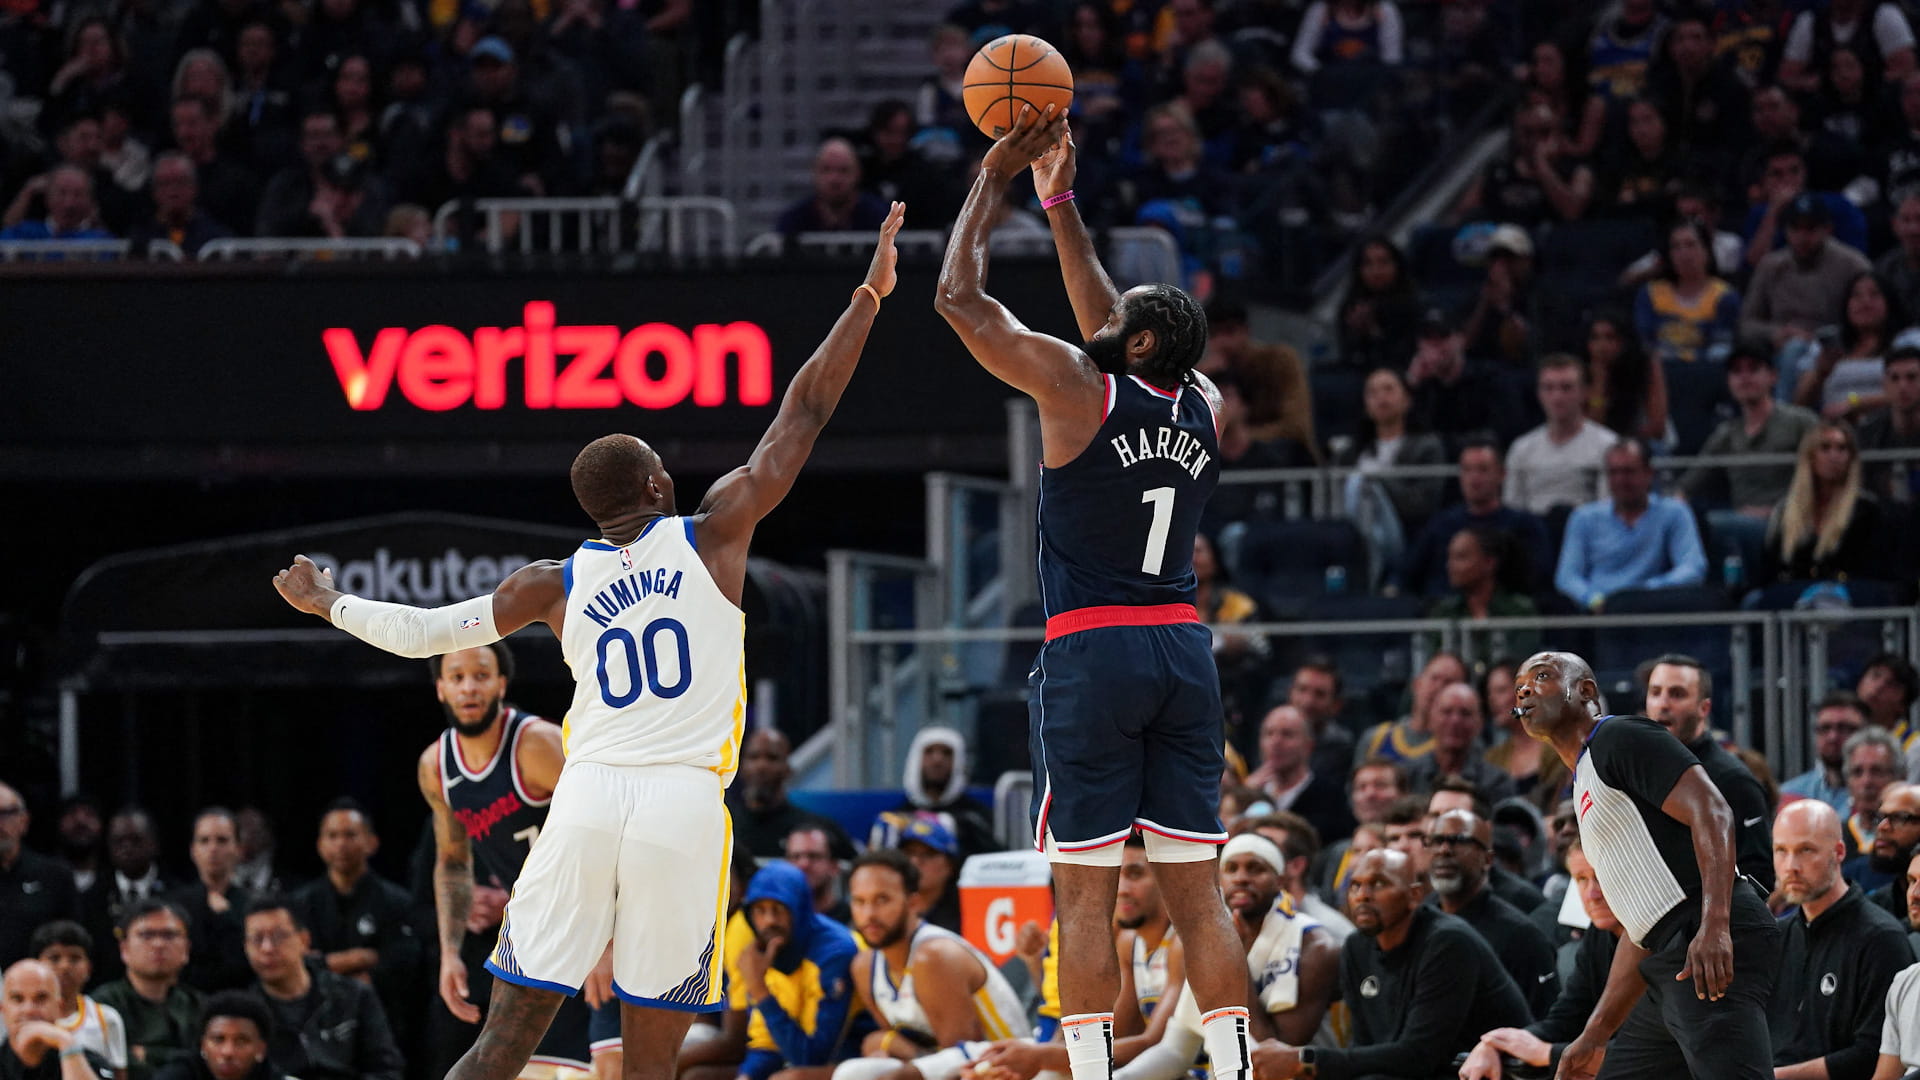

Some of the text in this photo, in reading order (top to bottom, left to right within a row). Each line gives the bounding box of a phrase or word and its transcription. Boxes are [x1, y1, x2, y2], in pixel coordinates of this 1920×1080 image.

[322, 300, 772, 411] verizon
[1111, 427, 1211, 480] HARDEN
[1141, 486, 1176, 576] 1
[583, 568, 683, 629] KUMINGA
[596, 617, 692, 708] 00
[985, 896, 1016, 955] G
